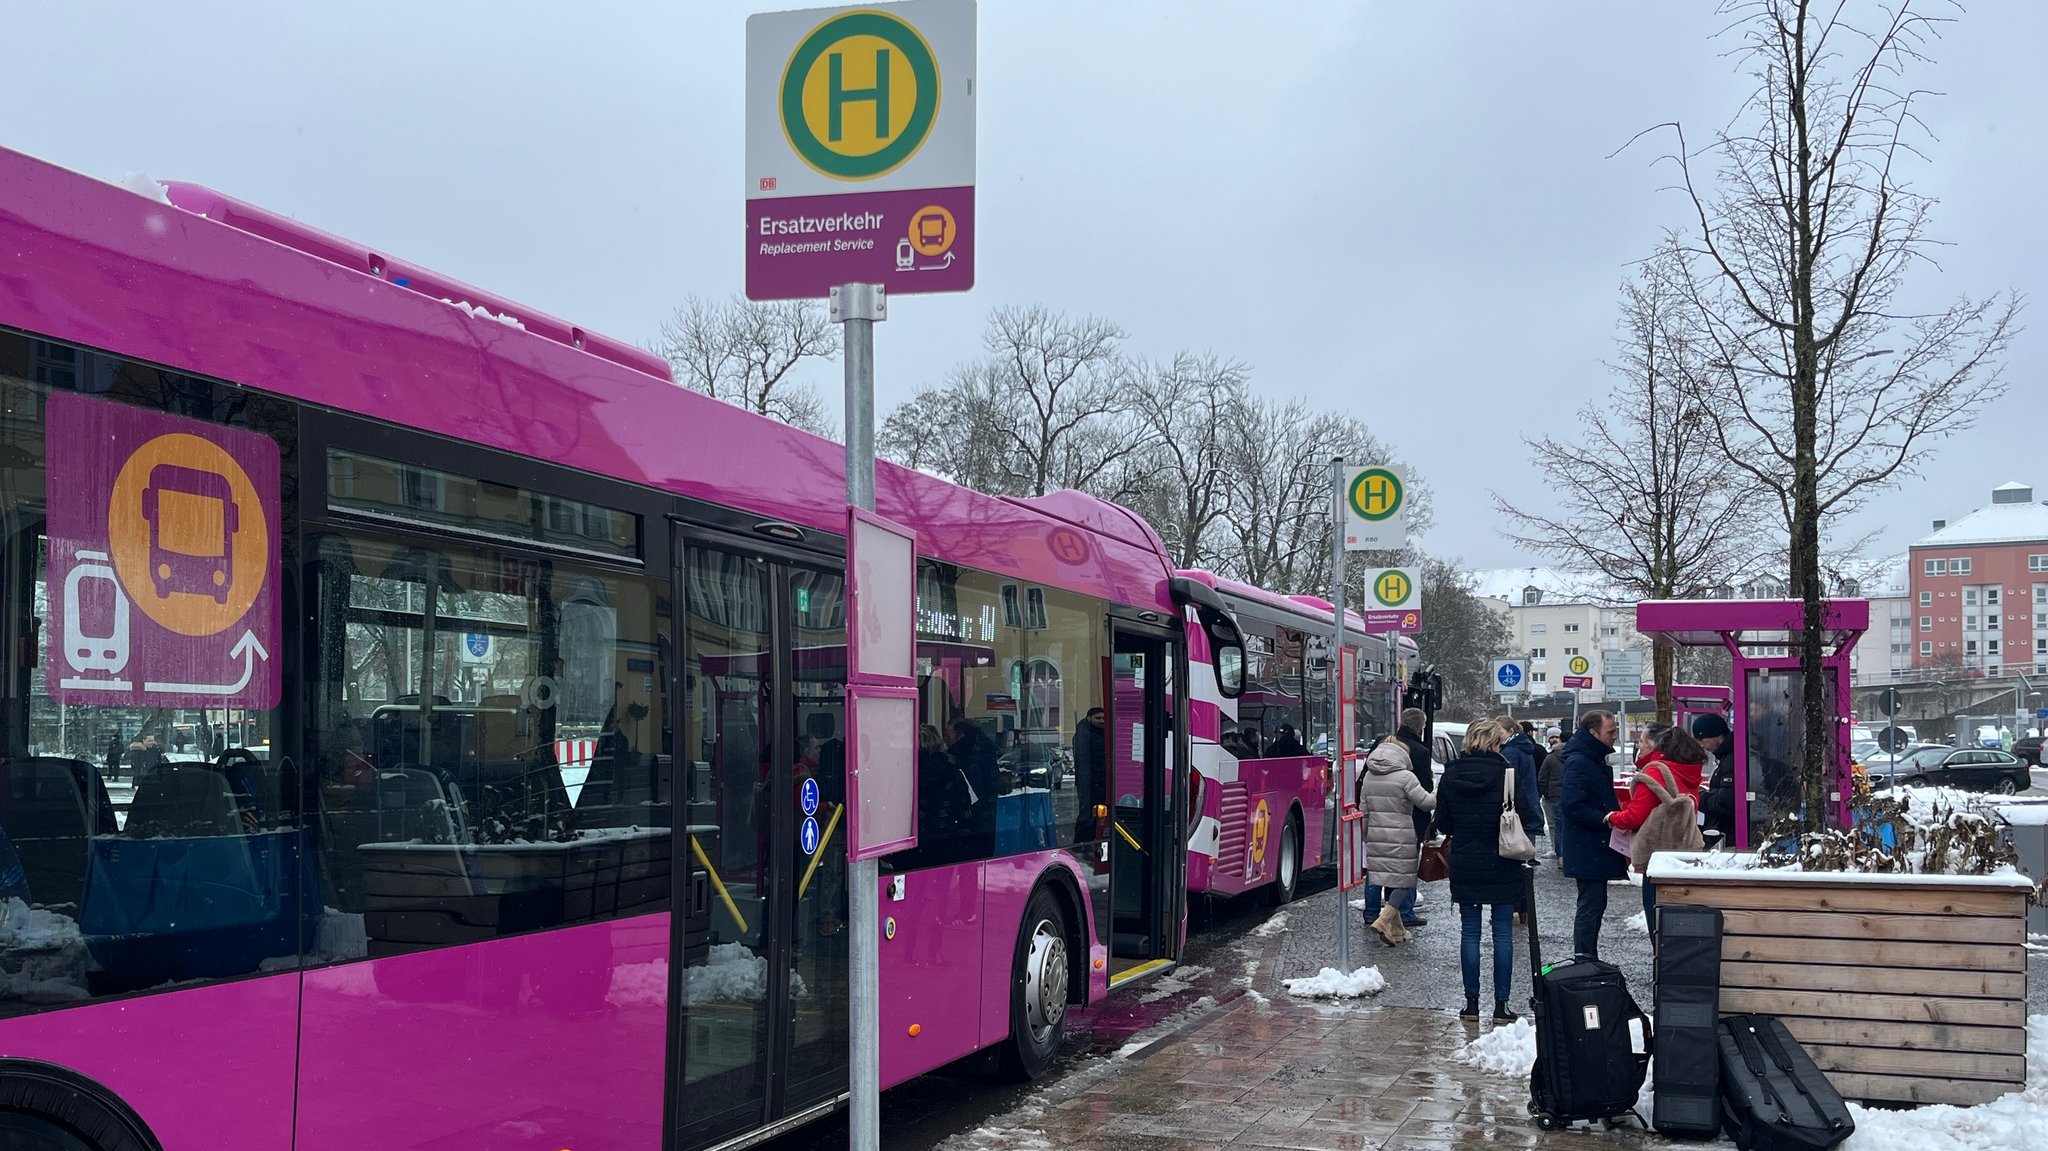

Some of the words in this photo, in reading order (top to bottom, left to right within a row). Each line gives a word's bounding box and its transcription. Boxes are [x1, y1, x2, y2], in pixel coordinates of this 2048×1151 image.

[828, 48, 890, 142] H
[761, 178, 776, 190] DB
[760, 211, 884, 236] Ersatzverkehr
[759, 240, 831, 256] Replacement
[833, 238, 874, 252] Service
[1365, 480, 1386, 509] H
[1385, 578, 1400, 598] H
[1574, 660, 1584, 671] H
